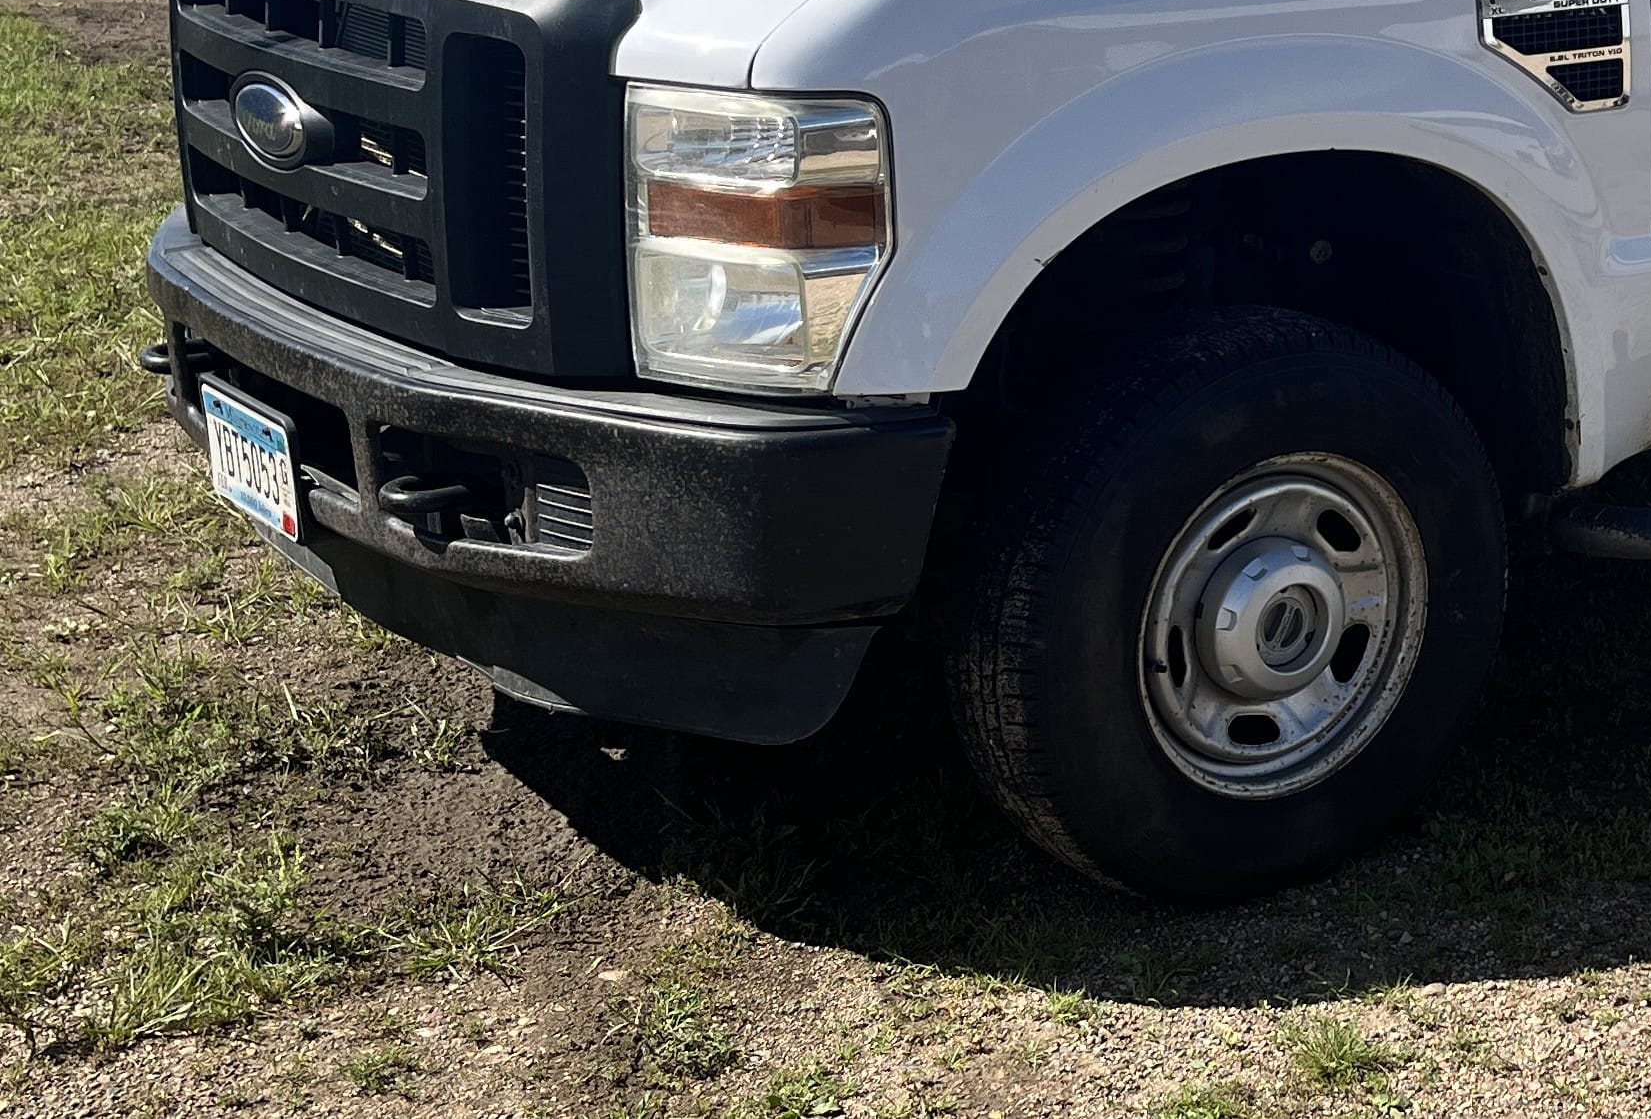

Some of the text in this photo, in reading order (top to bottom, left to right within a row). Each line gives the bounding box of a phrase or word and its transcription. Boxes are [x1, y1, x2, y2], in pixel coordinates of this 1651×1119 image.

[1491, 6, 1504, 15] XL
[1572, 50, 1605, 60] TRITON
[1608, 48, 1623, 56] V10
[213, 419, 280, 506] YBT5053
